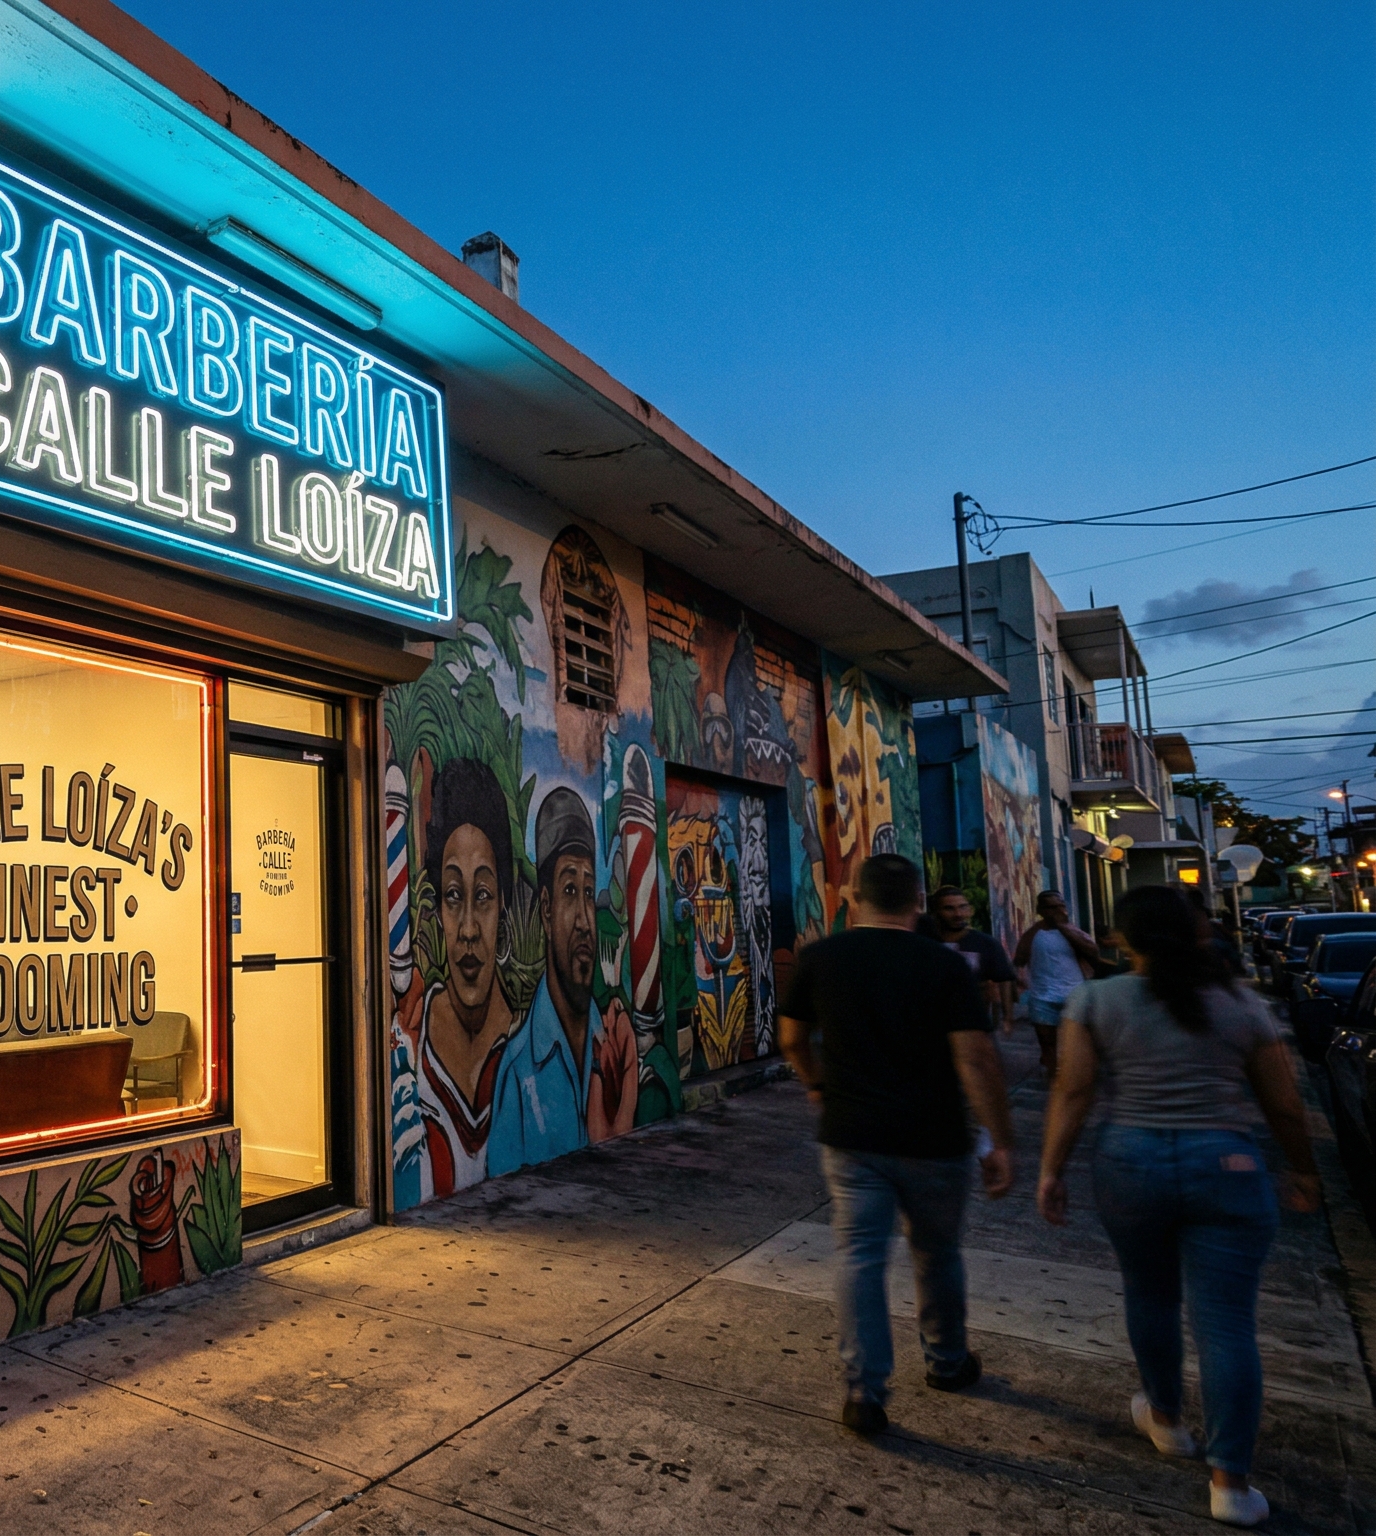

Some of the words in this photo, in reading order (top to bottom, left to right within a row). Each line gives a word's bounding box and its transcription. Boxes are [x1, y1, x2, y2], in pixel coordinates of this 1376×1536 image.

[255, 452, 441, 600] LOÍZA
[42, 762, 194, 892] LOÍZA'S
[255, 829, 296, 852] BARBERÍA
